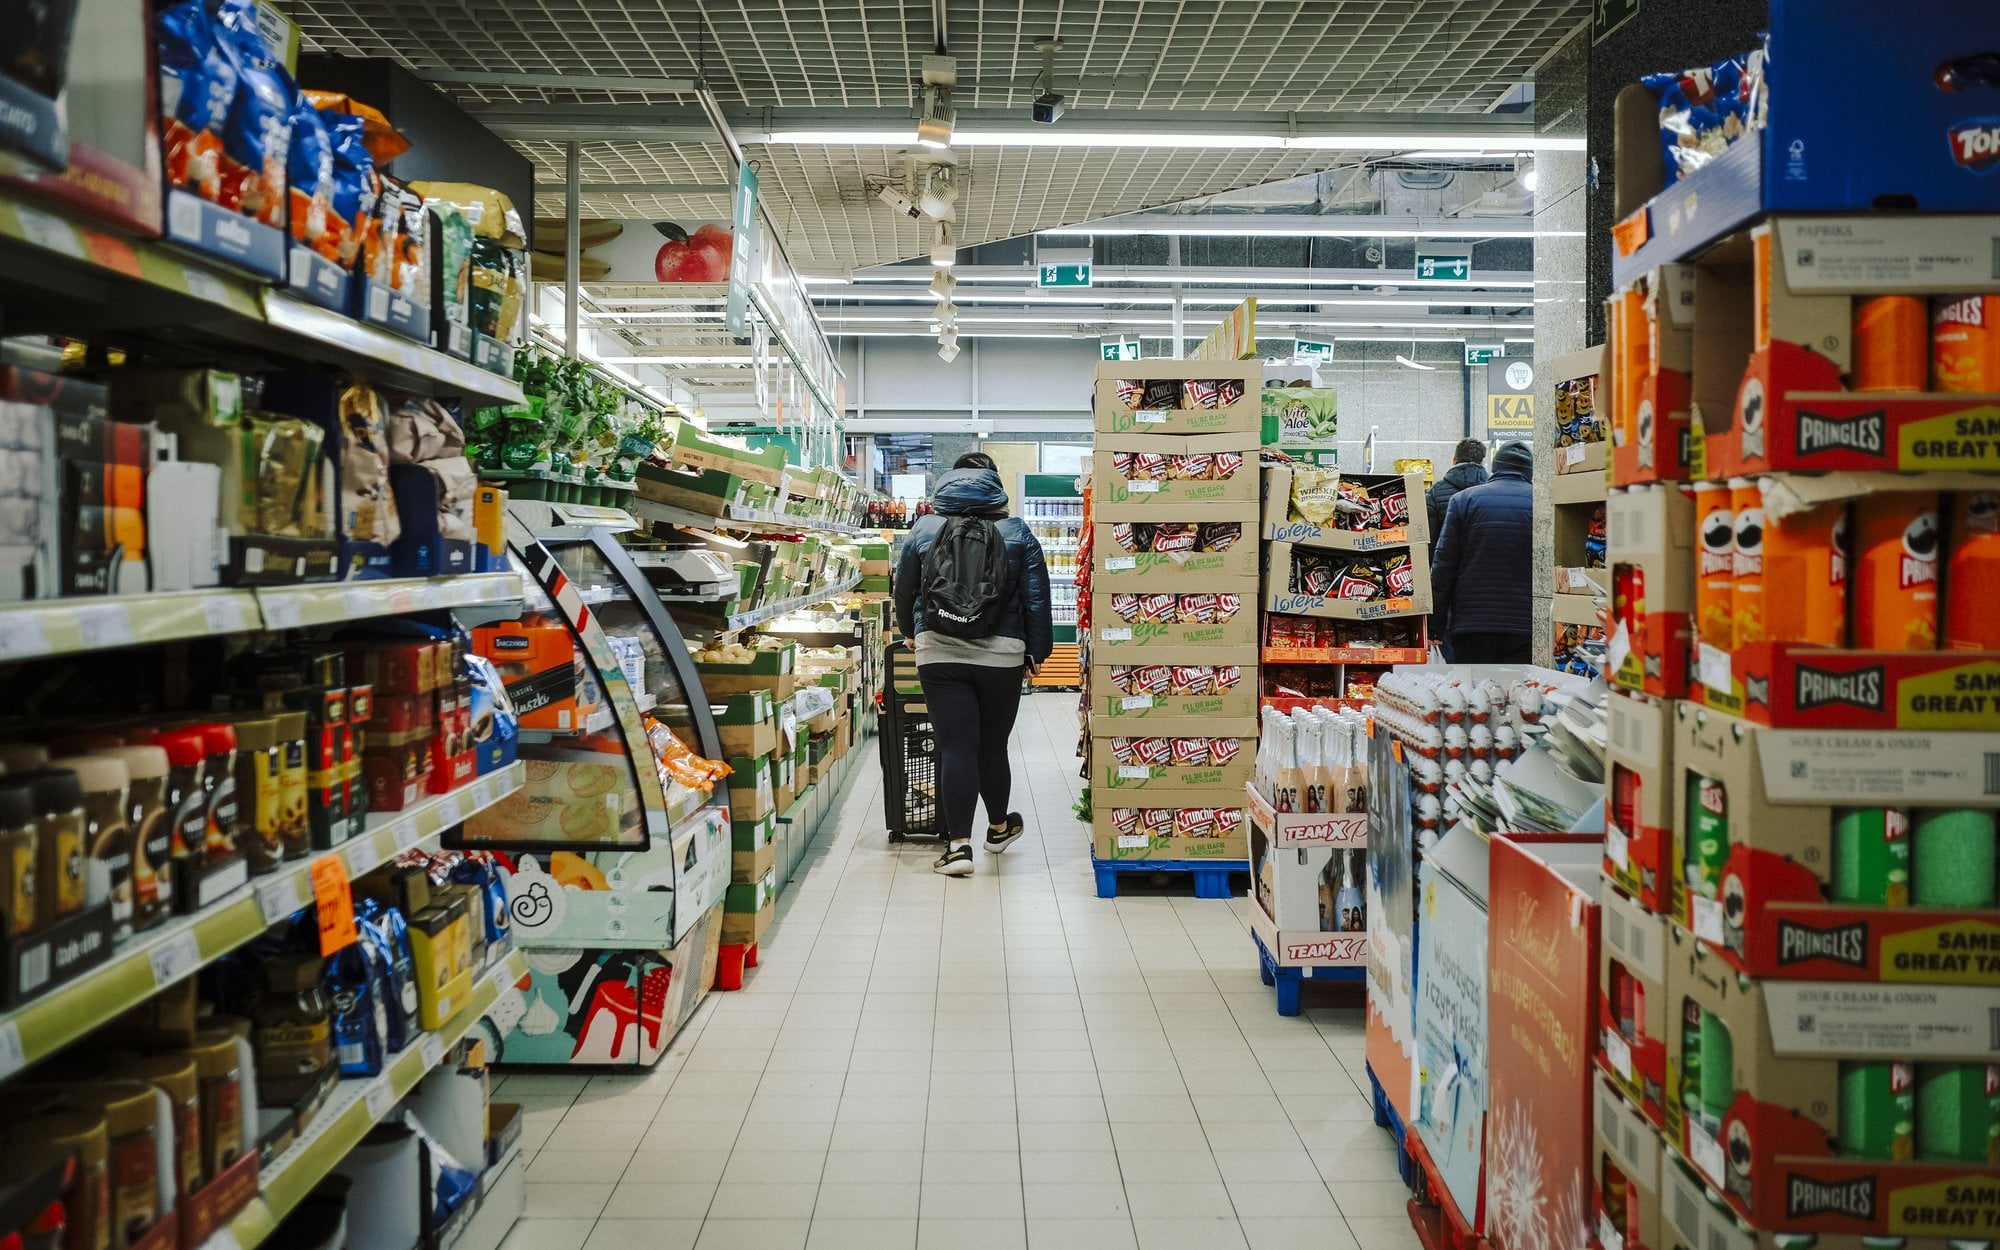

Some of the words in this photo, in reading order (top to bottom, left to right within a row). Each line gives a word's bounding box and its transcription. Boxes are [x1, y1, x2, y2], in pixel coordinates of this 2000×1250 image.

[1285, 407, 1308, 418] Vita
[1494, 398, 1533, 419] KA
[1285, 418, 1310, 429] Aloe
[1801, 416, 1880, 451] PRINGLES
[1913, 440, 1989, 458] GREAT
[1300, 487, 1337, 497] WIEJSKIE
[1155, 534, 1196, 552] Crunchips
[938, 608, 968, 624] Reebok
[1800, 671, 1879, 705] PRINGLES
[1911, 695, 1987, 713] GREAT
[1782, 926, 1863, 962] PRINGLES
[1938, 932, 2000, 950] SAME
[1894, 953, 1970, 971] GREAT
[1791, 1179, 1870, 1216] PRINGLES
[1903, 1205, 1979, 1225] GREAT
